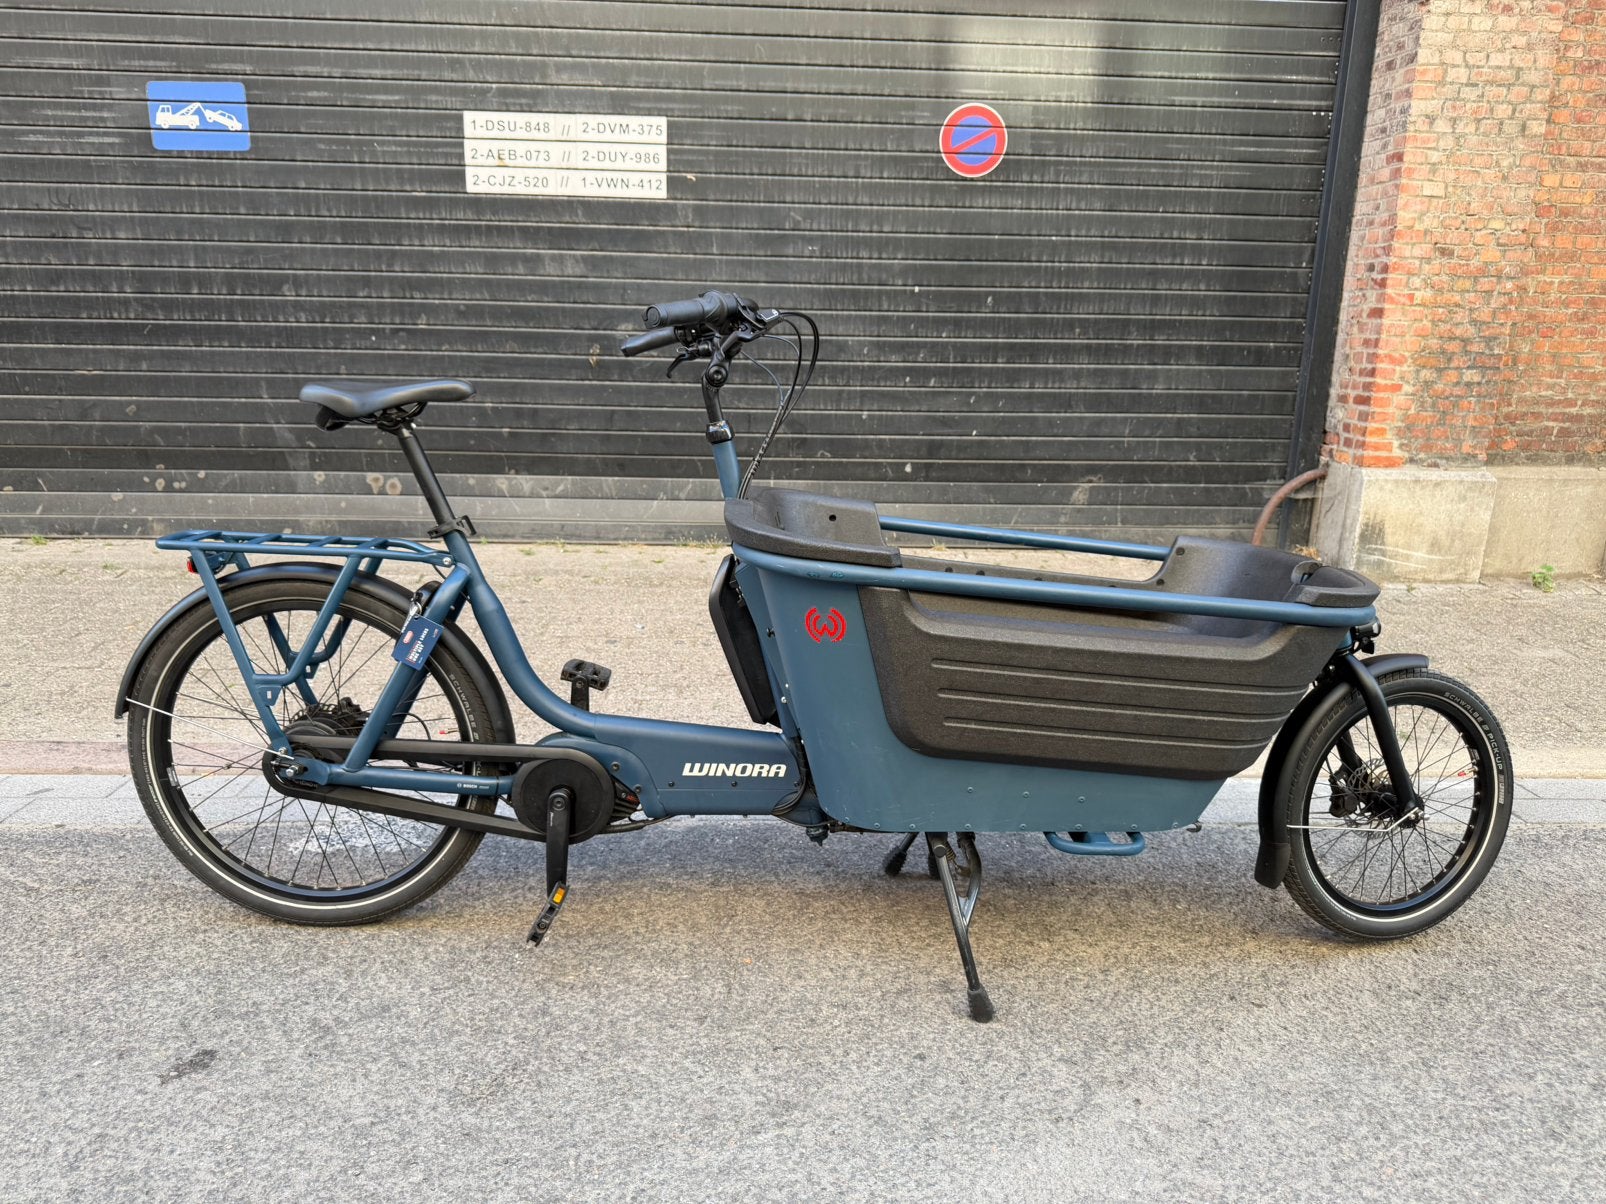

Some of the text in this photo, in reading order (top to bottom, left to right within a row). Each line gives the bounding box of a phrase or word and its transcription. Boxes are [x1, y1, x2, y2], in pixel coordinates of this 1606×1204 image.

[471, 119, 550, 133] 1-DSU-848
[582, 122, 663, 136] 2-DVM-375
[471, 148, 551, 162] 2-AEB-073
[582, 150, 660, 164] 2-DUY-986
[472, 174, 549, 188] 2-CJZ-520
[581, 177, 663, 190] 1-VWN-412
[449, 673, 477, 728] SCHWALBE
[1443, 691, 1484, 723] SCHWALBE
[1487, 733, 1503, 770] PICK-UP
[682, 762, 787, 778] WINORA
